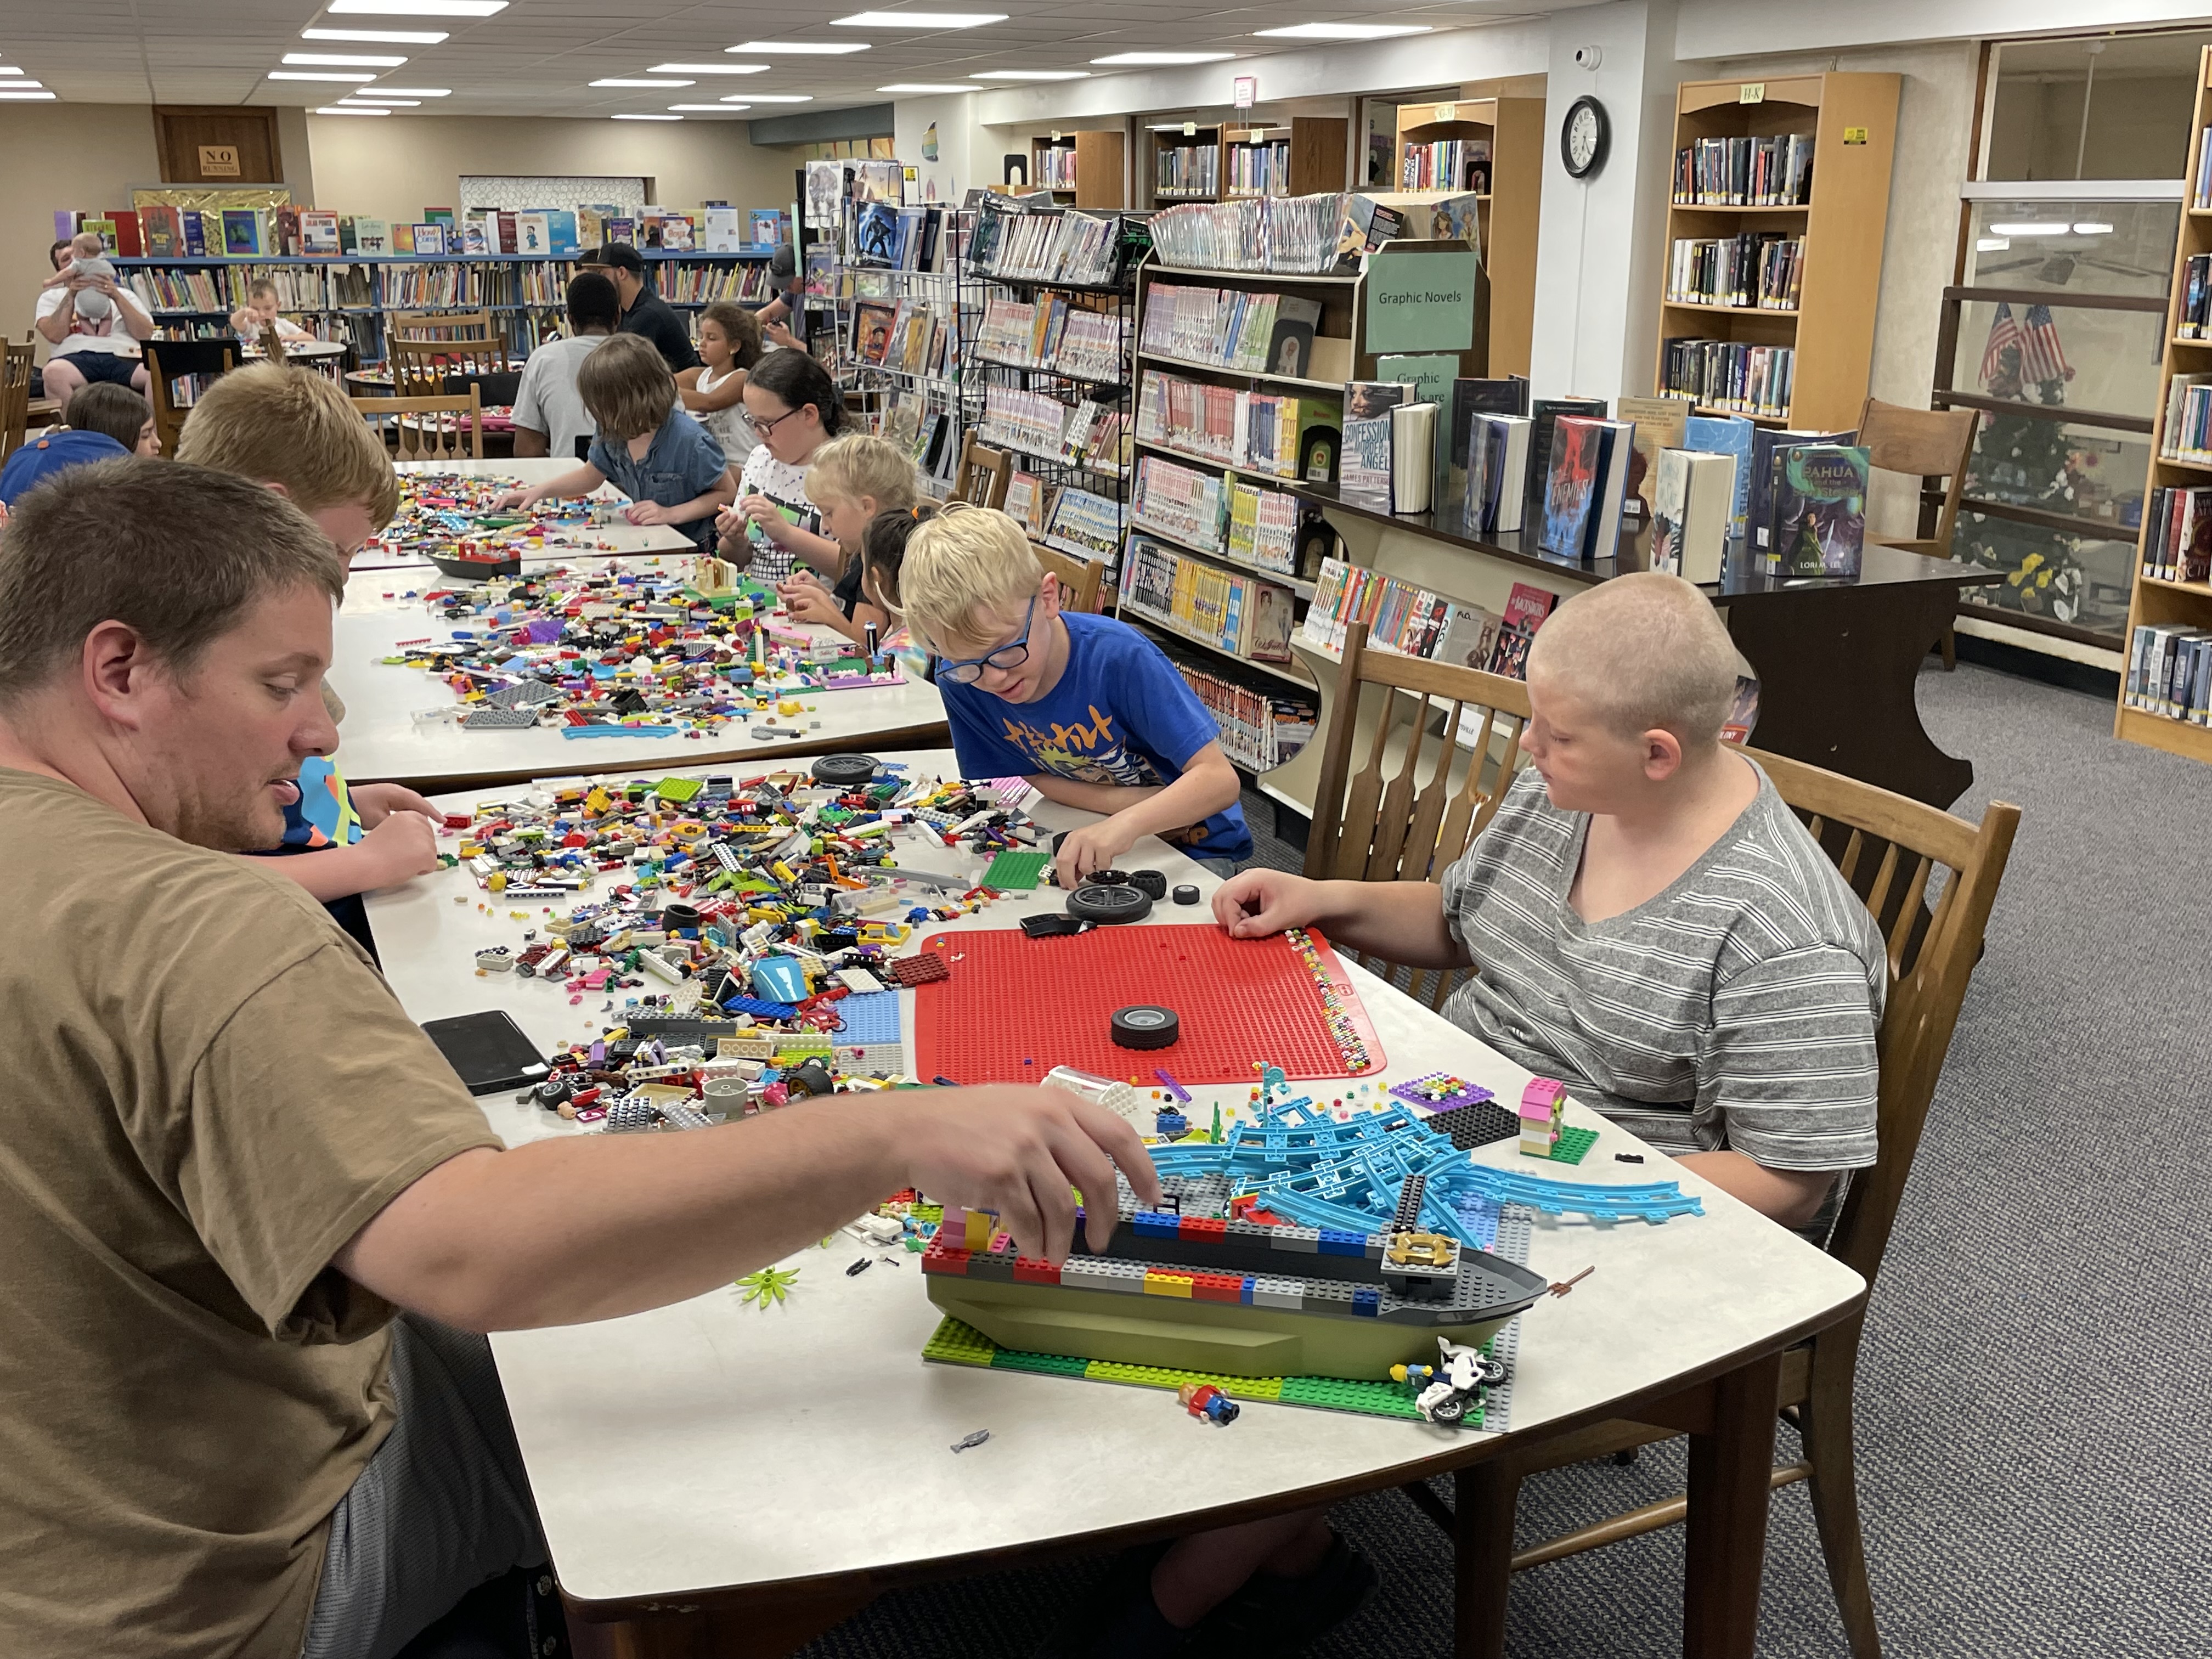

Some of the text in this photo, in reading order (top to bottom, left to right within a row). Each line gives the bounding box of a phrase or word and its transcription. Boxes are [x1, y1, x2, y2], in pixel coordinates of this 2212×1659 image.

[1743, 87, 1761, 100] H-K
[206, 151, 232, 161] NO
[1379, 291, 1462, 306] Graphic Novels
[1397, 371, 1440, 387] Graphic
[1354, 441, 1384, 454] MURDER
[1361, 455, 1390, 471] ANGEL
[1803, 466, 1854, 478] PAHUA
